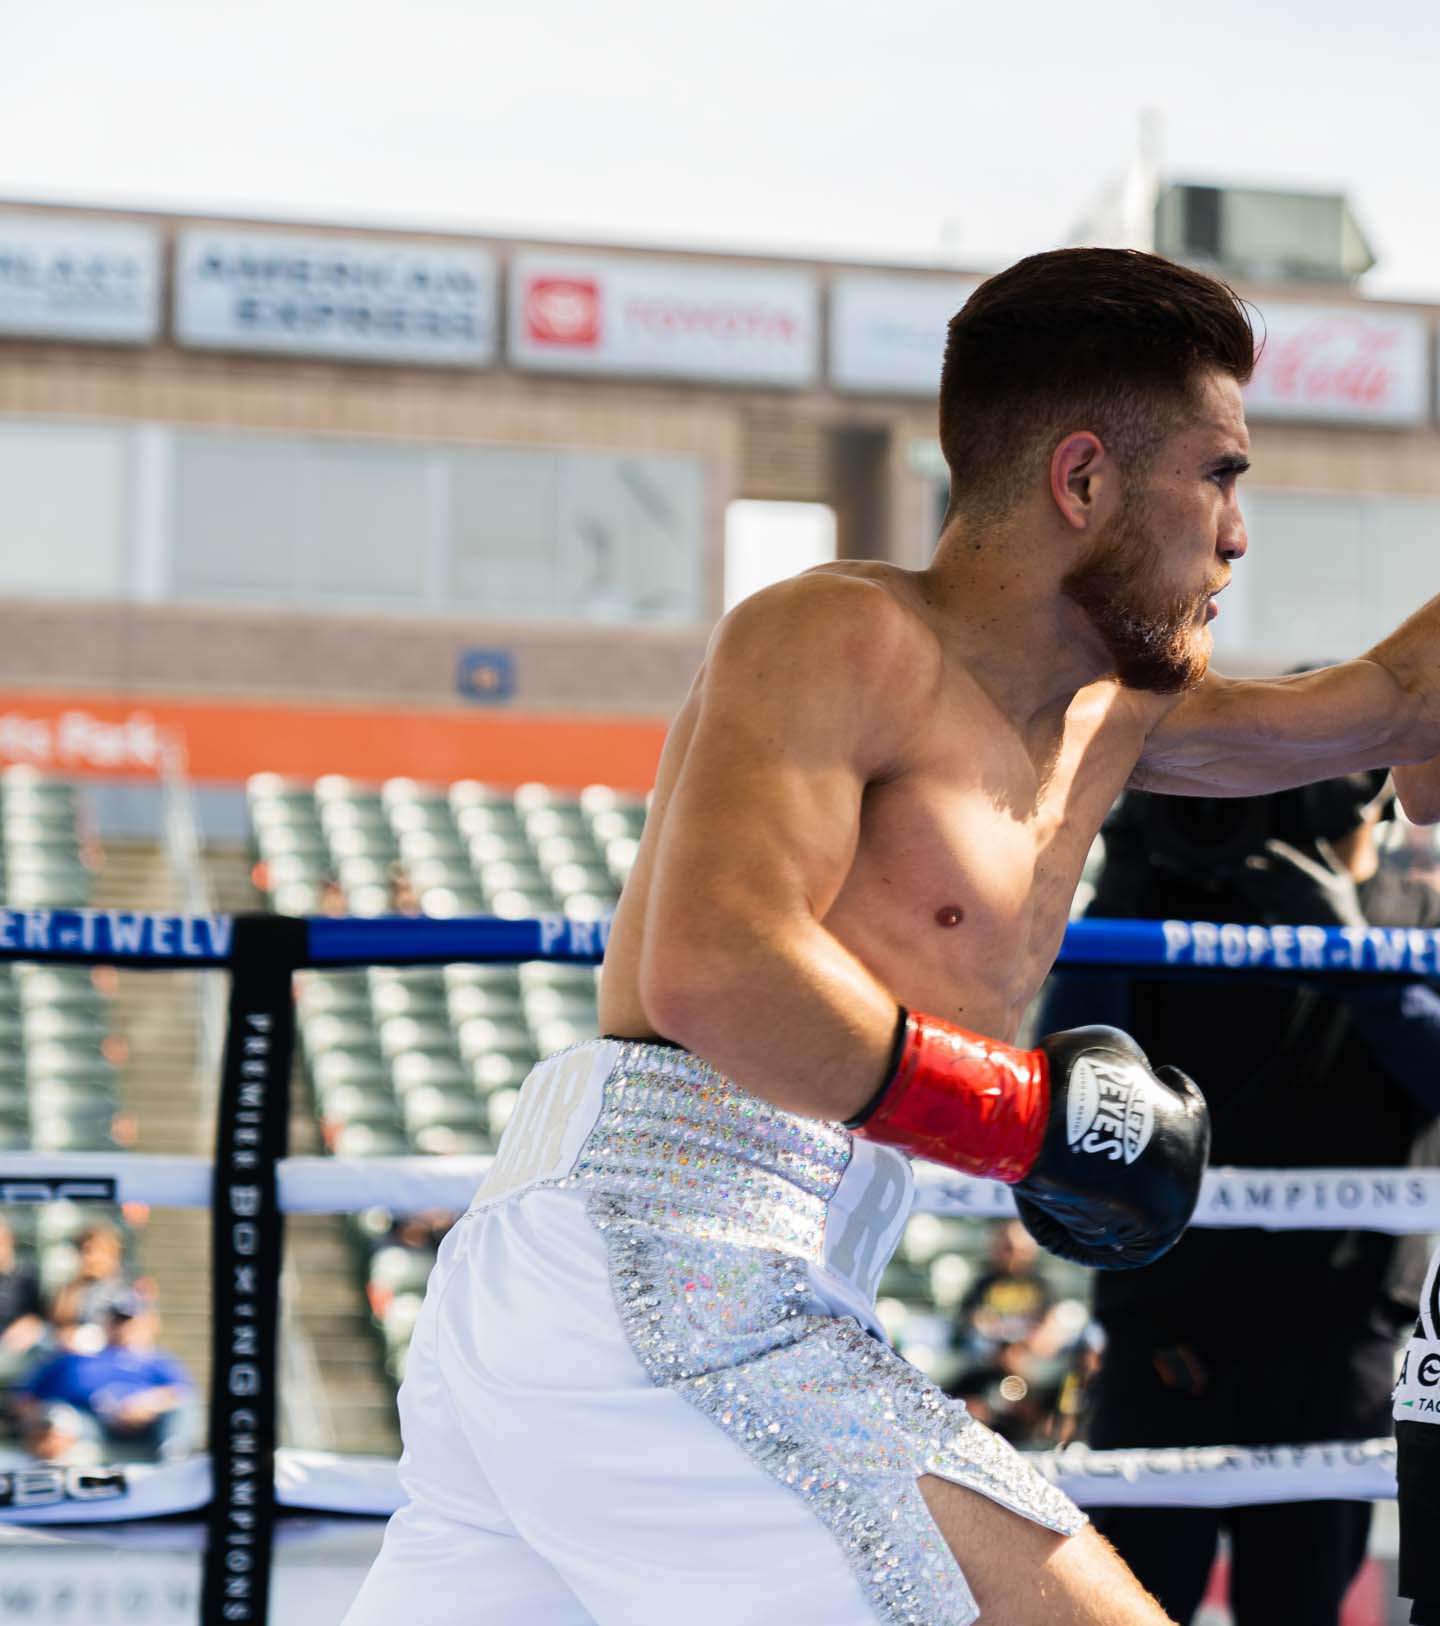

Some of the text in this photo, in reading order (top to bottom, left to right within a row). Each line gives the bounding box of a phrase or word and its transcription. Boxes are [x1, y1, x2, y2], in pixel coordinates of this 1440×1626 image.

[200, 249, 478, 293] AMERICAN
[235, 299, 477, 341] EXPRESS
[624, 295, 800, 343] TOYOTA
[1162, 919, 1328, 968] PROPER
[223, 1013, 273, 1621] PREMIER BOXING CHAMPIONS
